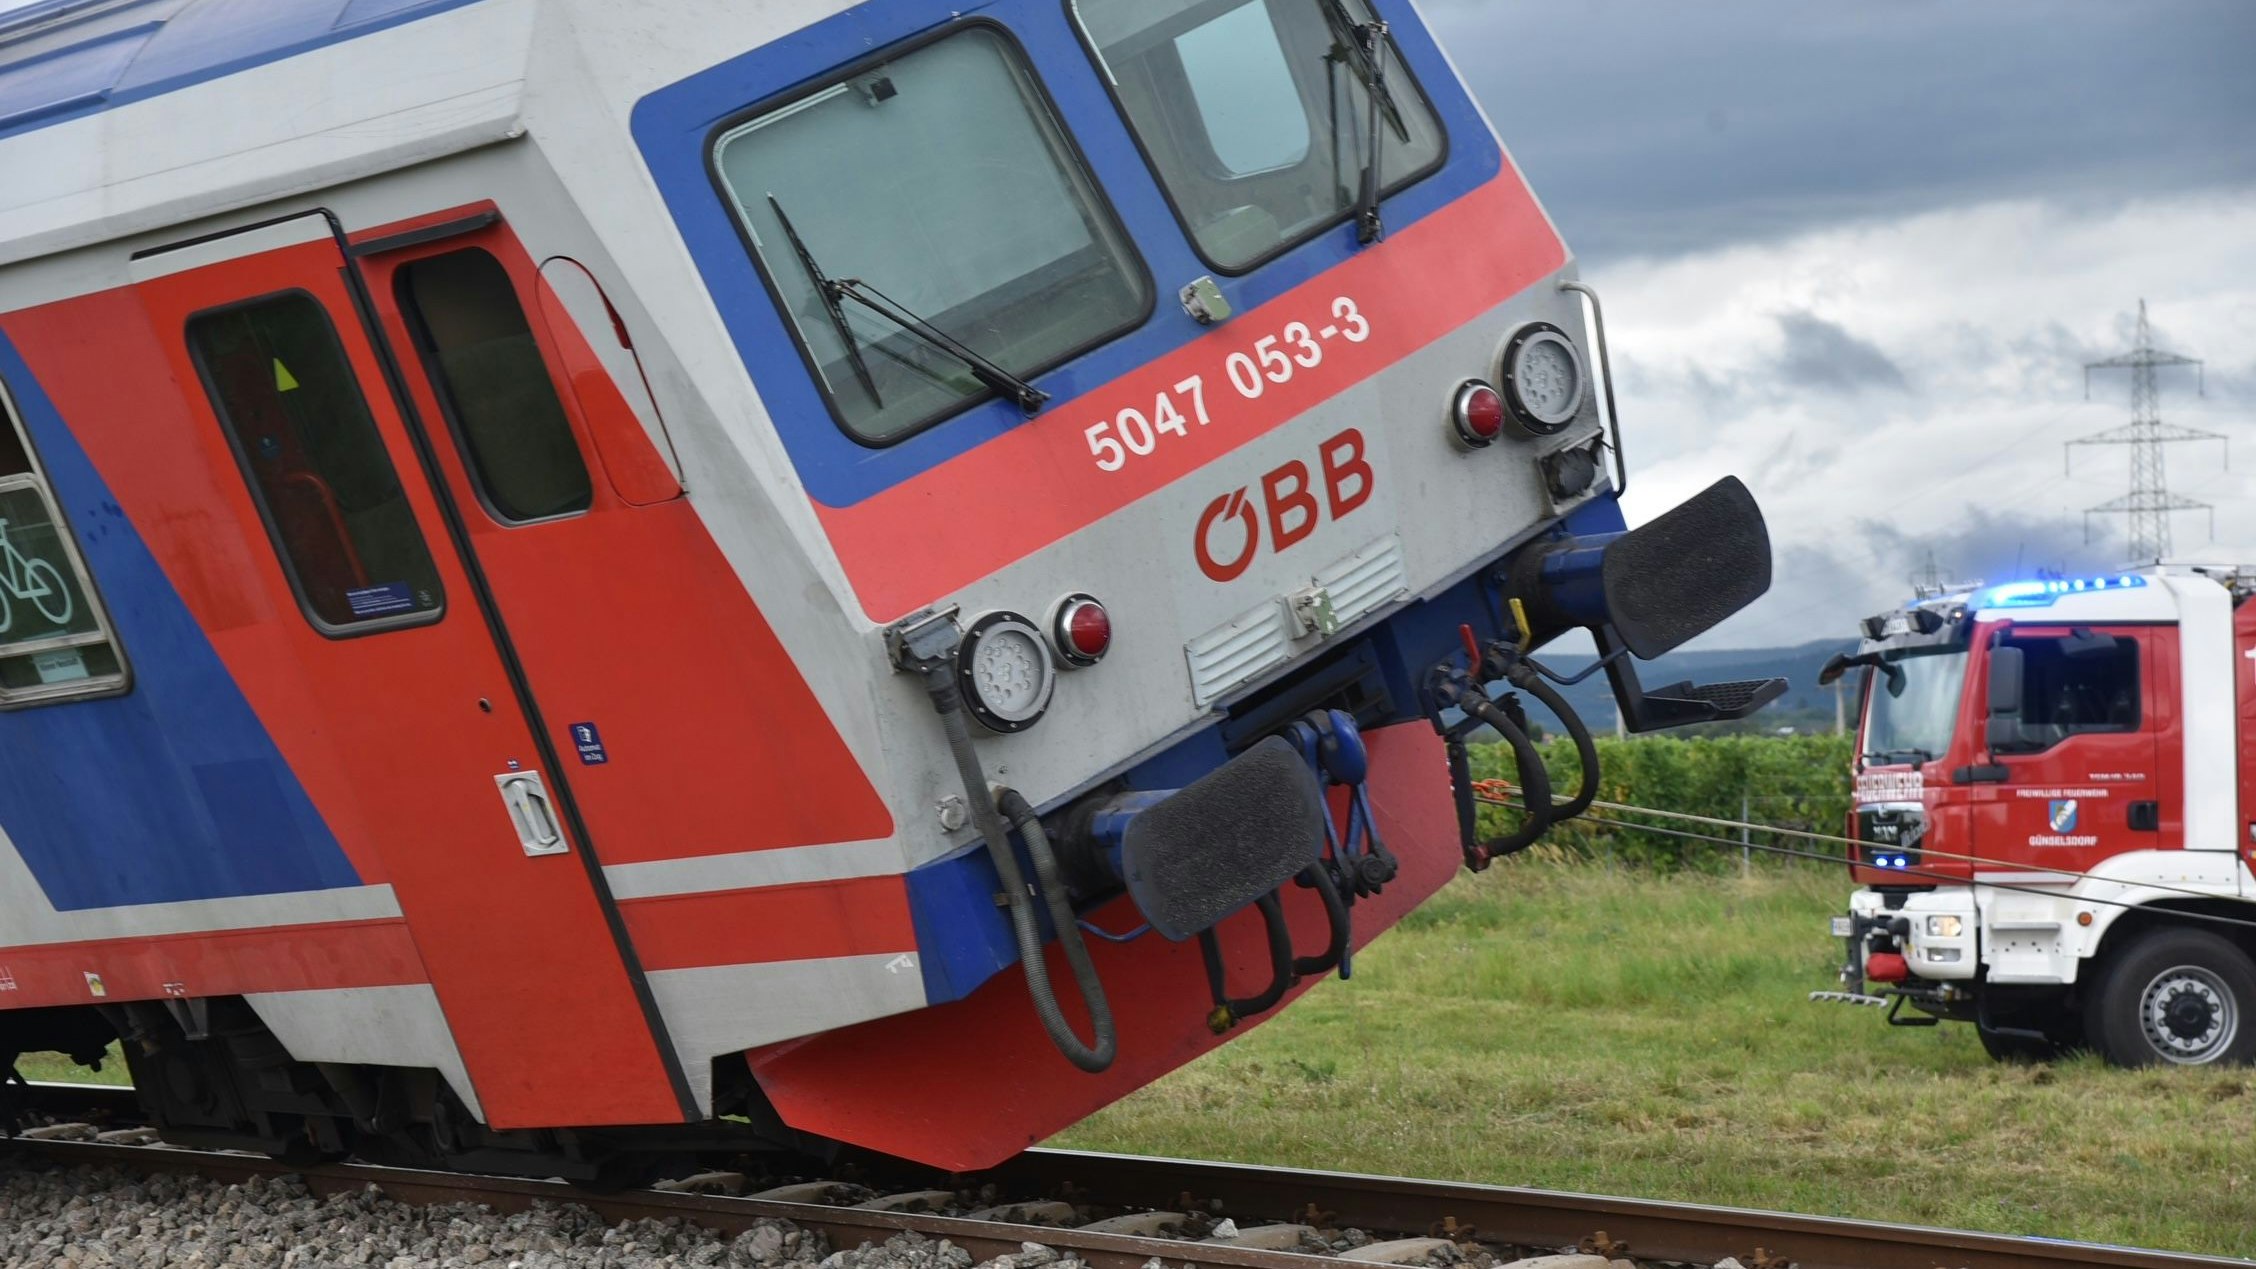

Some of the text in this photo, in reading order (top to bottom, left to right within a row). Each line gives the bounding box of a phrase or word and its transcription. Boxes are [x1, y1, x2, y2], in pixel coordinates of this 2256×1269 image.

[1084, 296, 1370, 471] 5047 053-3
[1194, 427, 1374, 583] ÖBB
[2063, 788, 2109, 798] FEUERWEHR
[2029, 834, 2098, 847] GÜNSELSDORF
